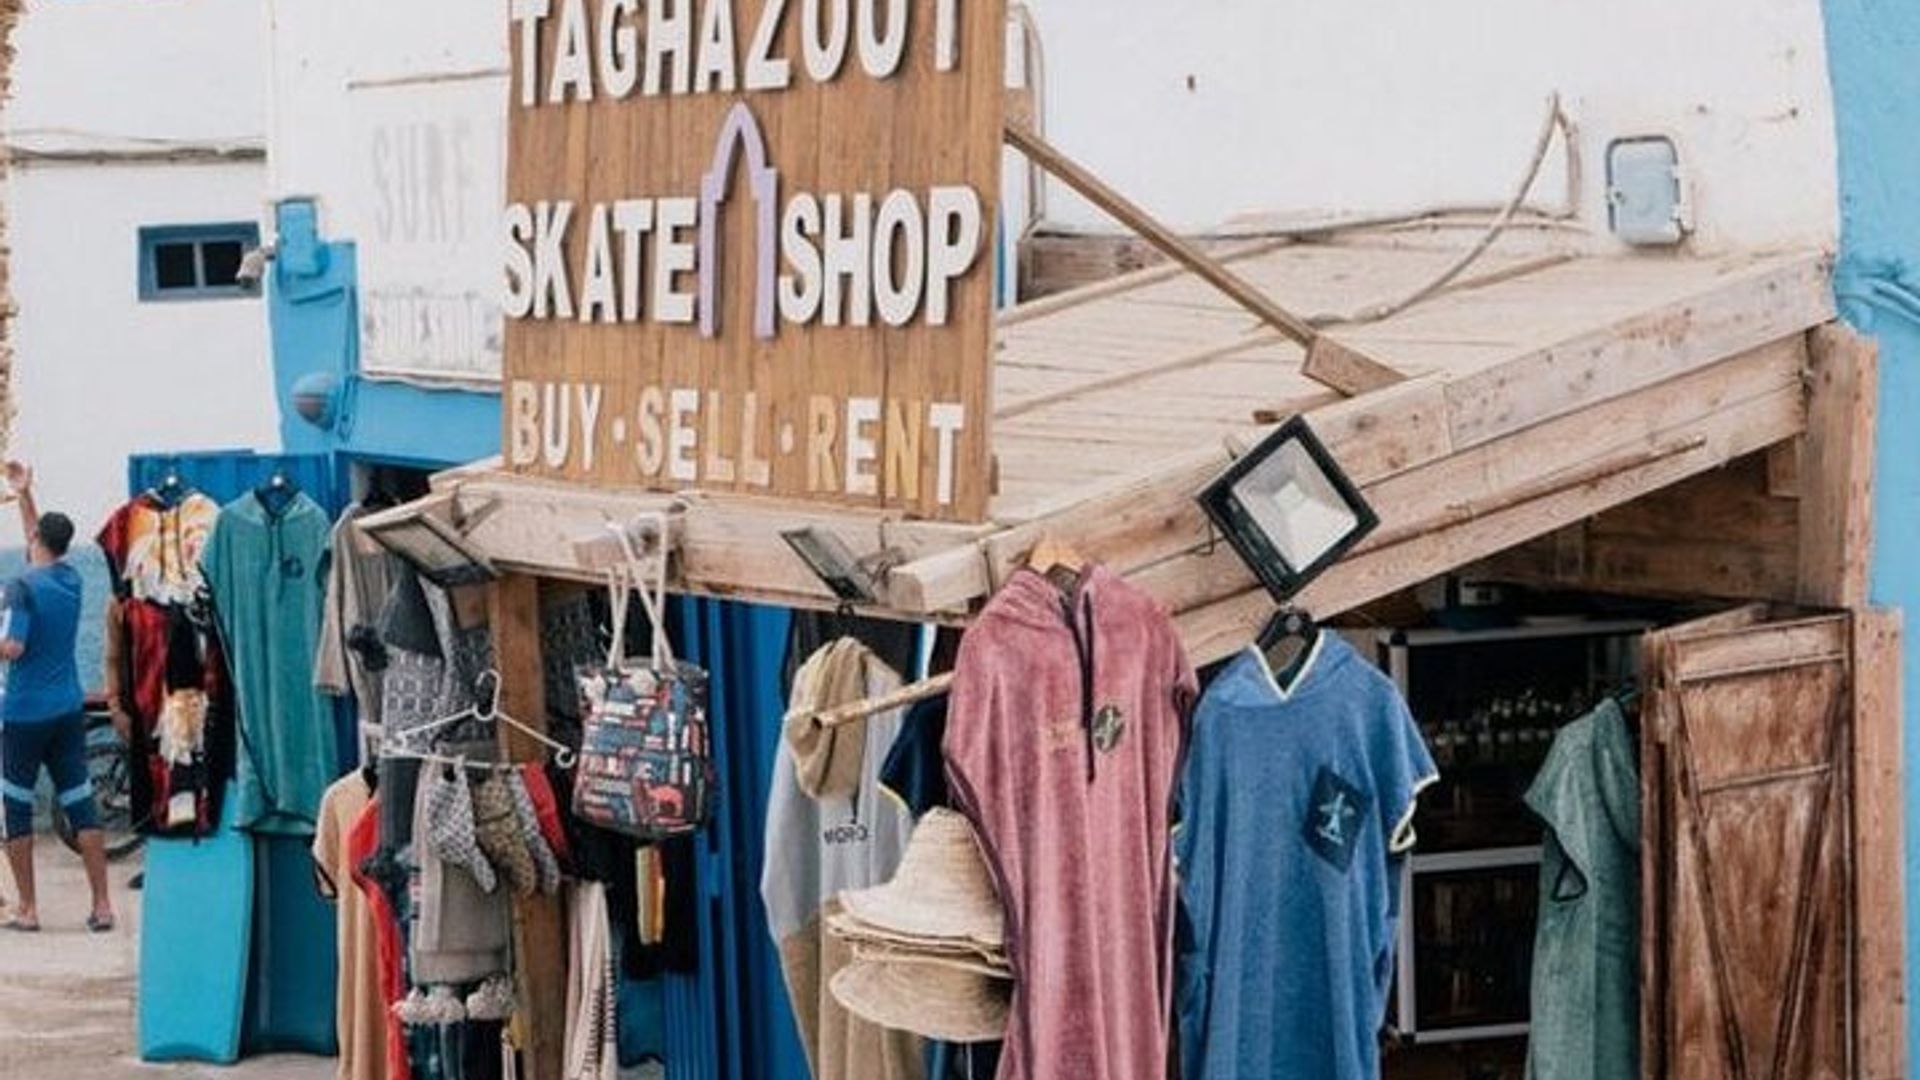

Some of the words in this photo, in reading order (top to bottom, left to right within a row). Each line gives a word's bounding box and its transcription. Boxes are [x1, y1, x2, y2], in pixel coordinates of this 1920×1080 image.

[504, 197, 697, 323] SKATE
[779, 186, 982, 326] SHOP
[511, 380, 601, 470] BUY
[636, 386, 771, 486] SELL
[808, 397, 964, 505] RENT
